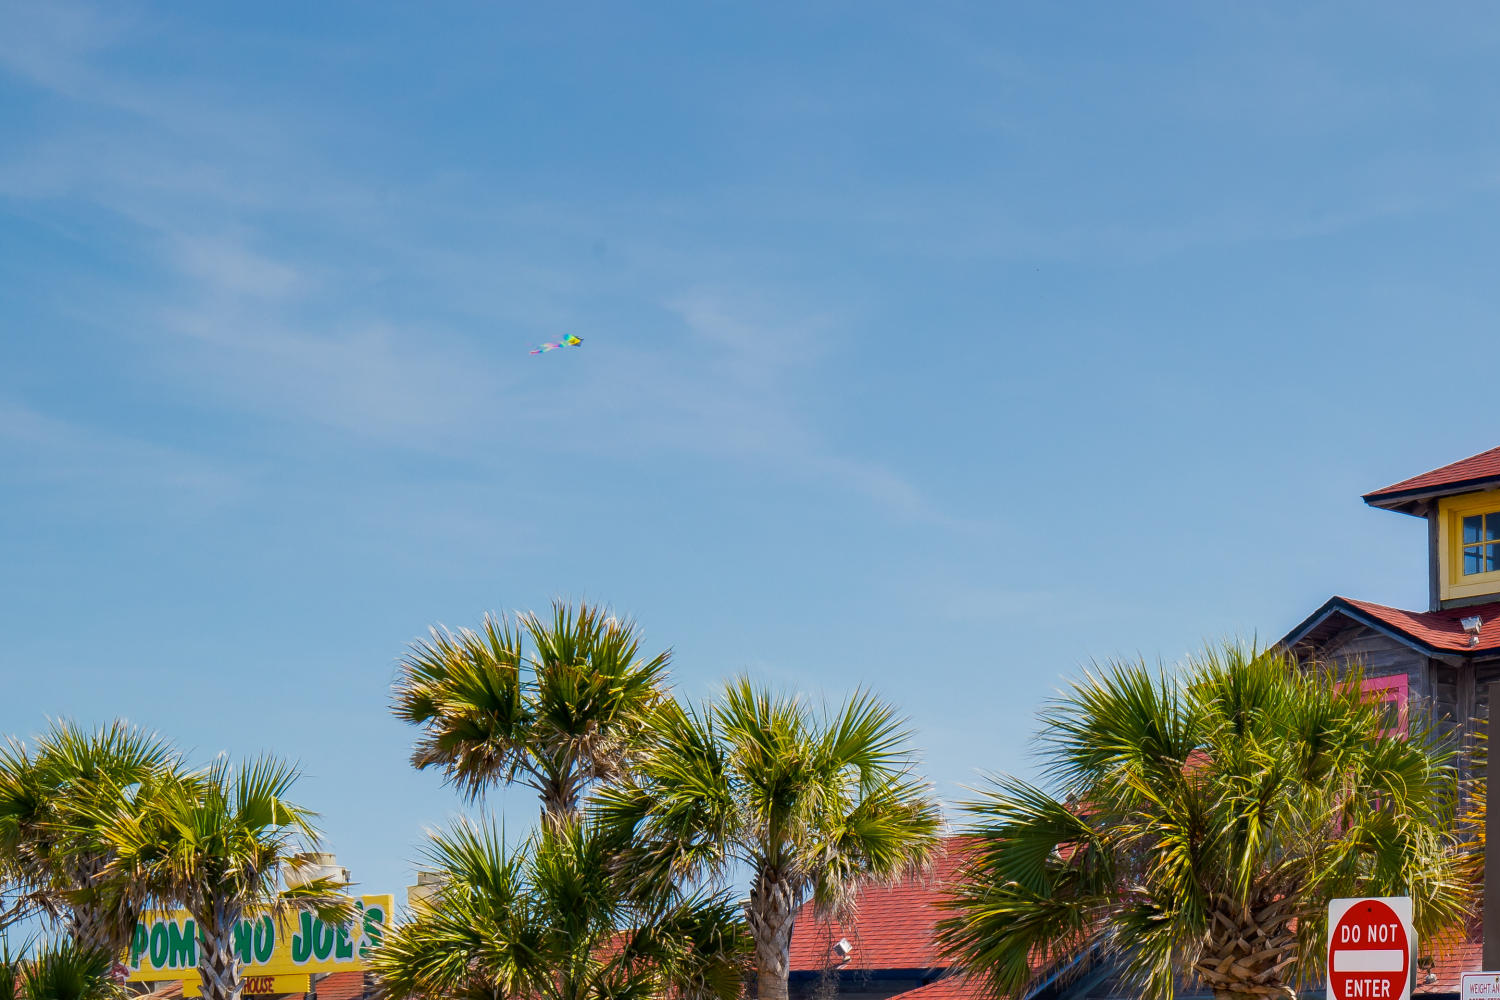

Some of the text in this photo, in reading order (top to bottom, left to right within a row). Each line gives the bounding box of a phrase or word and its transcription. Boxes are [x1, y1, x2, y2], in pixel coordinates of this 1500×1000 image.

[131, 914, 275, 969] POMNO
[1341, 924, 1398, 943] DO NOT
[243, 977, 275, 993] HOUSE
[1345, 979, 1391, 998] ENTER
[1469, 984, 1491, 994] WEIGHT
